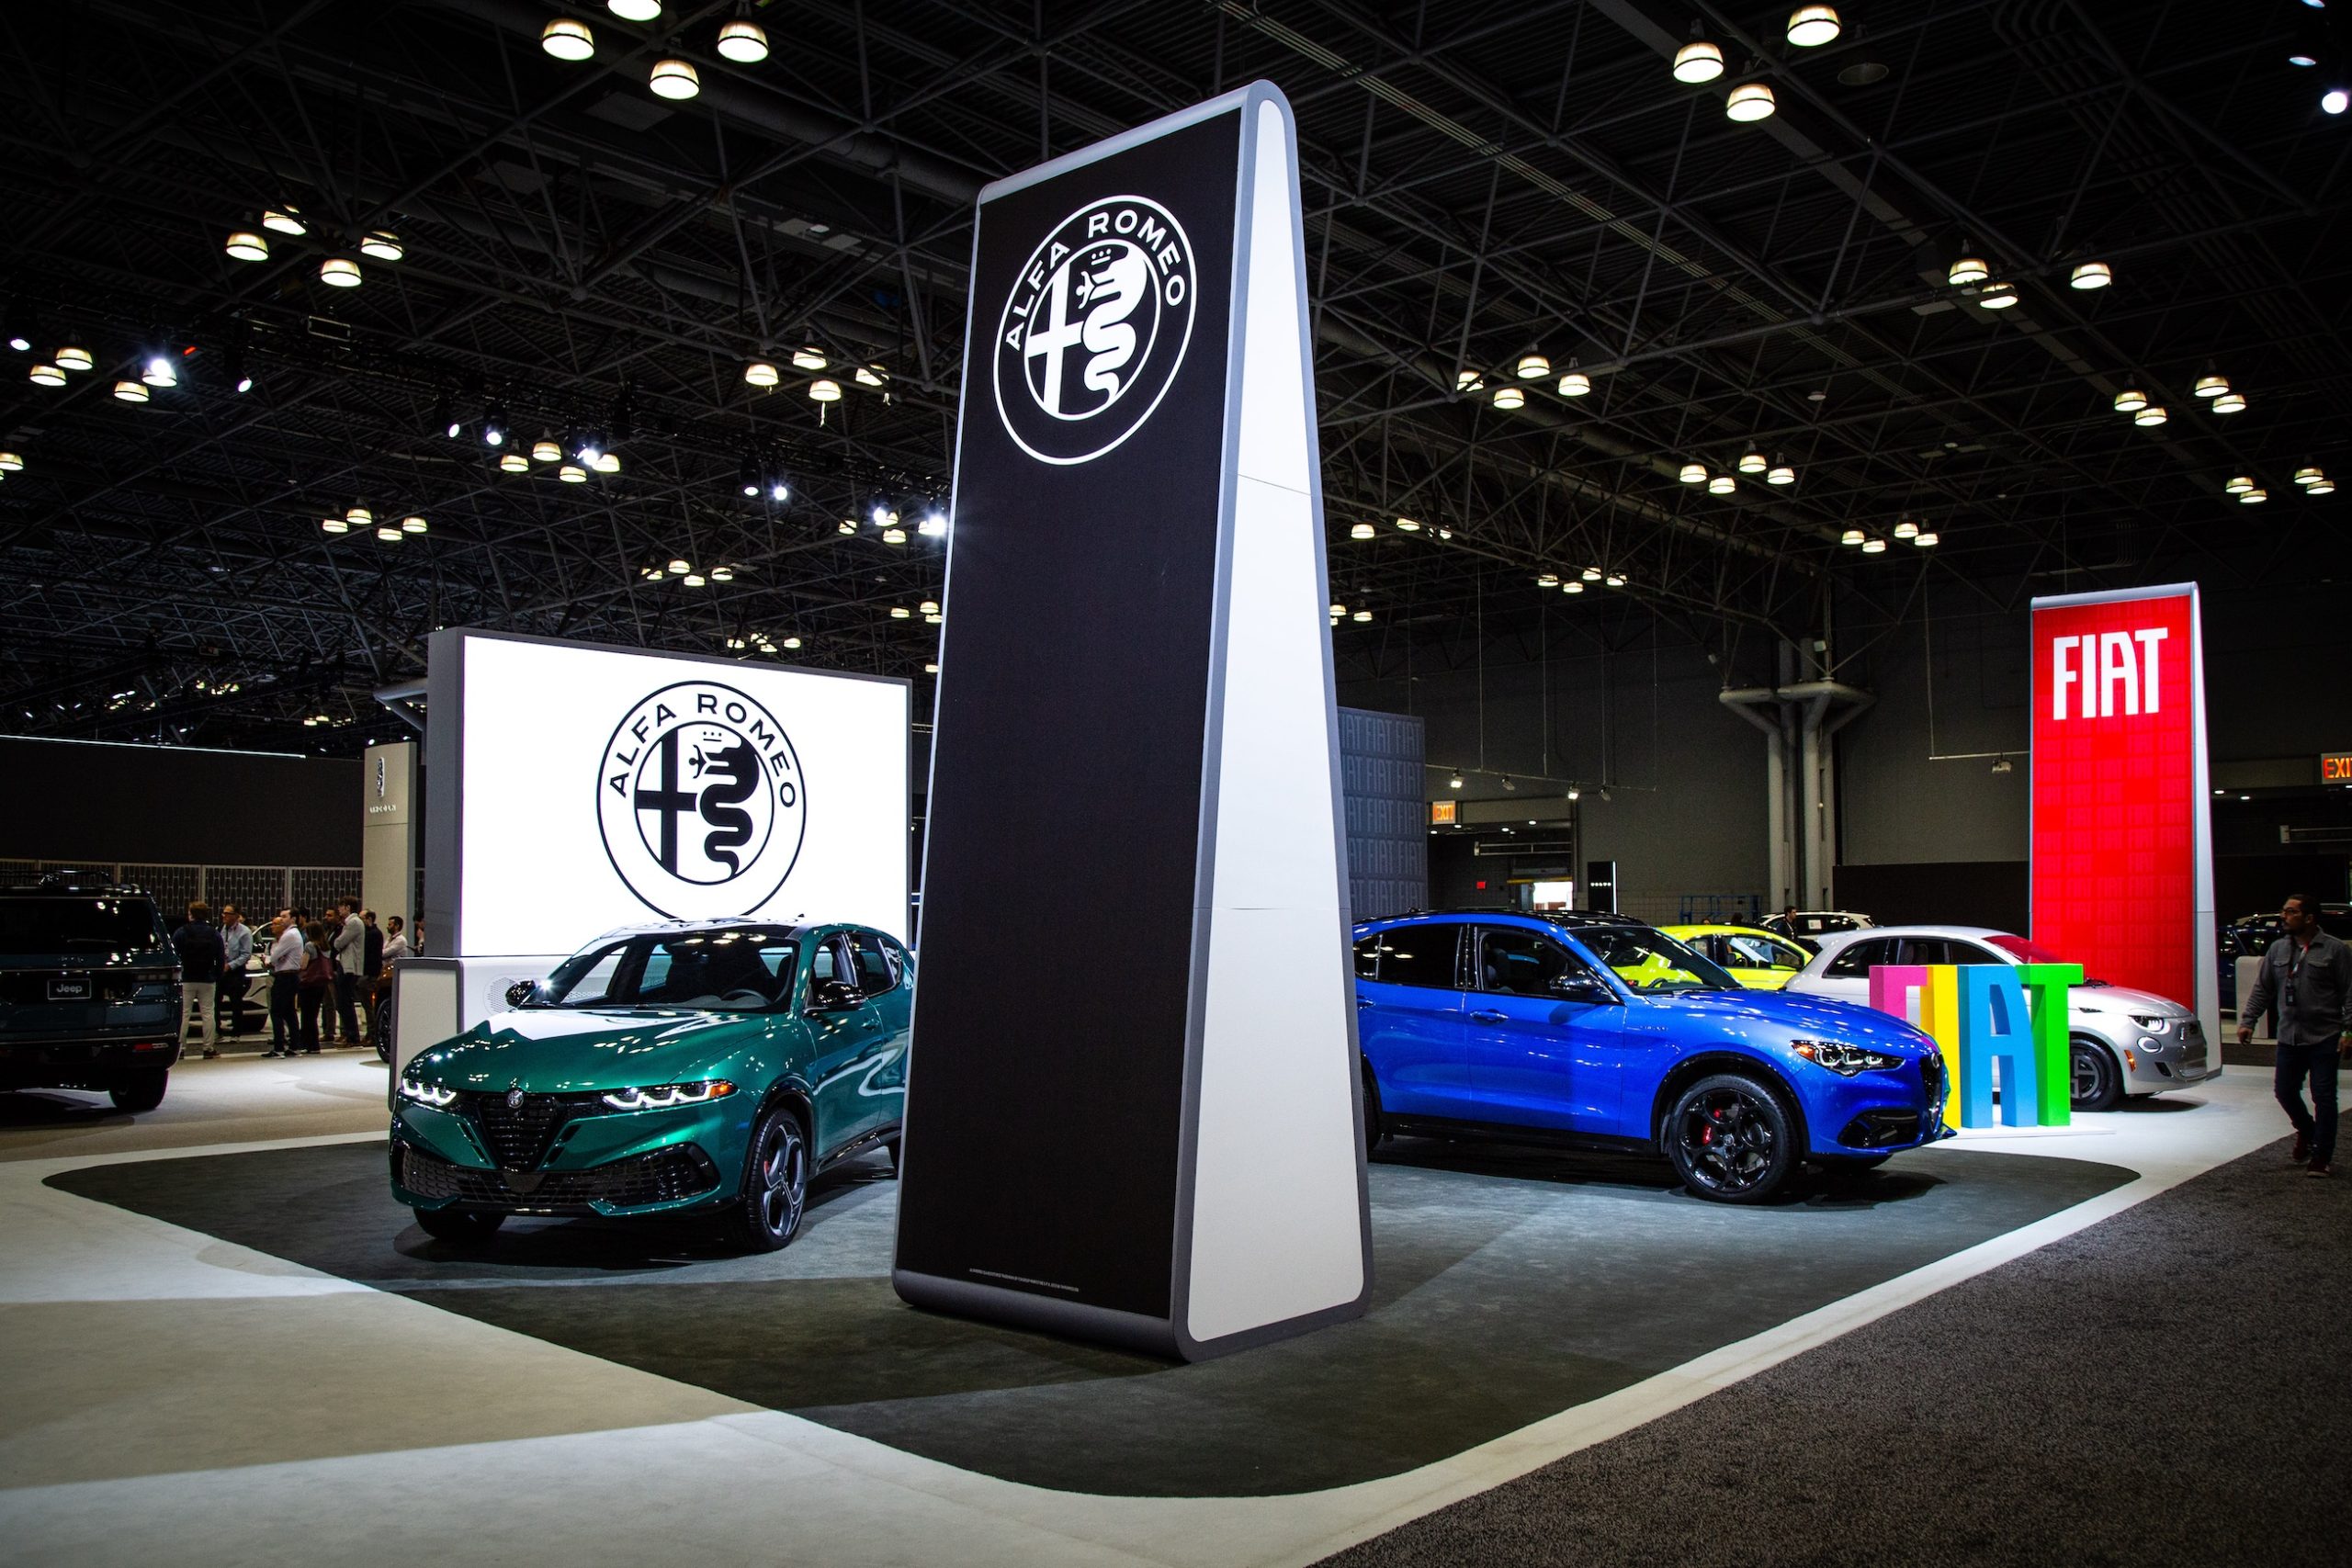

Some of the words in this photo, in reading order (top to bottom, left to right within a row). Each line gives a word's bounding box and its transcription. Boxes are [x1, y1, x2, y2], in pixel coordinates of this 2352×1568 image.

[1006, 241, 1070, 351] ALFA
[1087, 209, 1186, 307] ROMEO
[2052, 626, 2168, 721] FIAT
[609, 703, 677, 798] ALFA
[697, 694, 796, 807] ROMEO
[1340, 713, 1363, 750] IAT
[1365, 716, 1393, 754] FIAT
[1396, 721, 1421, 758] FIAT
[1342, 755, 1363, 791] IAT
[1366, 759, 1393, 795] FIAT
[1396, 761, 1422, 796] FIAT
[2323, 758, 2352, 779] EXI
[1344, 795, 1363, 832] AT
[1367, 798, 1394, 834] FIAT
[1397, 801, 1422, 836] FIAT
[1433, 805, 1454, 820] EXIT
[1348, 837, 1364, 873] AT
[1368, 839, 1394, 874] FIAT
[1398, 840, 1423, 875] FIAT
[1368, 880, 1395, 915] FIAT
[1398, 881, 1423, 913] FIAT
[56, 983, 83, 993] Jeep
